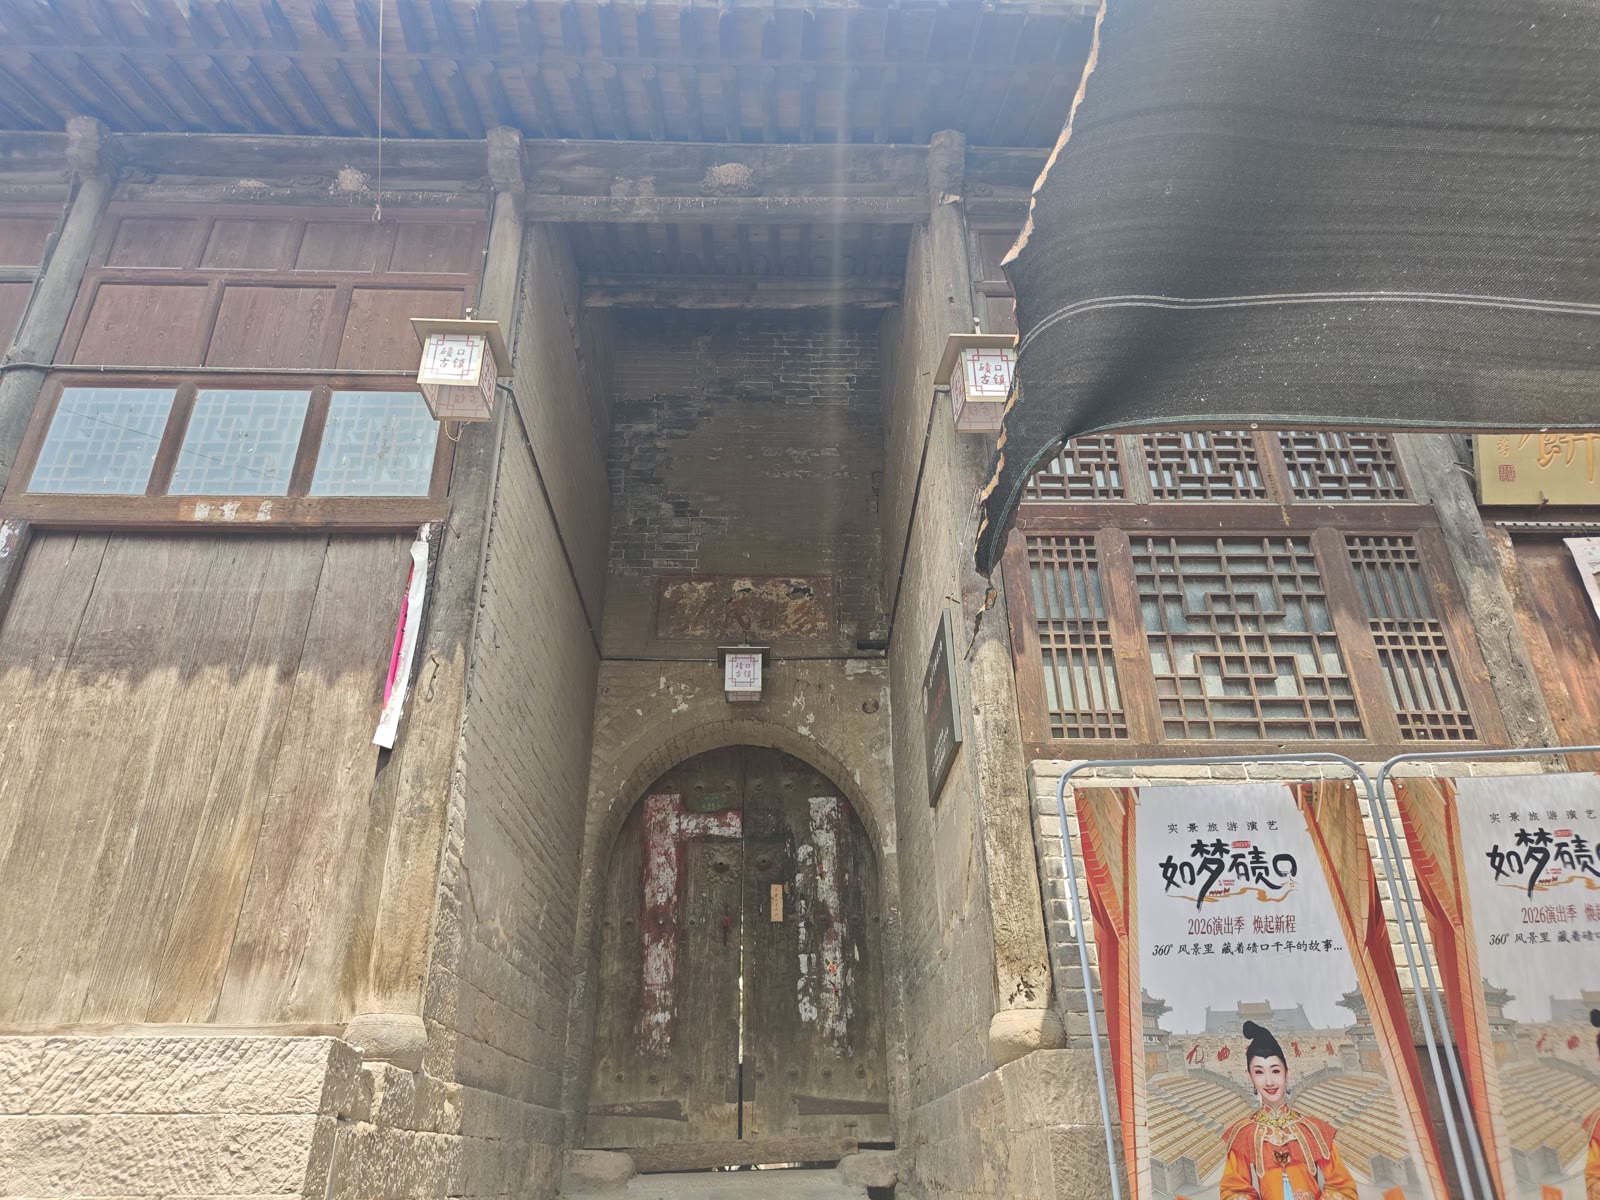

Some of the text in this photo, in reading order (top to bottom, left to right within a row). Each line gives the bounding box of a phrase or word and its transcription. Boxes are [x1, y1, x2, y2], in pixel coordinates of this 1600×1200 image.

[1489, 808, 1597, 824] 实景旅游演艺
[1167, 820, 1279, 834] 实景旅游演艺
[1485, 828, 1600, 902] 如梦碛
[1159, 839, 1298, 912] 如梦碛口
[1521, 904, 1577, 924] 2026演出季
[1188, 914, 1297, 935] 2026演出季 焕起新程
[1514, 931, 1551, 944] 风景里
[1177, 942, 1215, 956] 风景里
